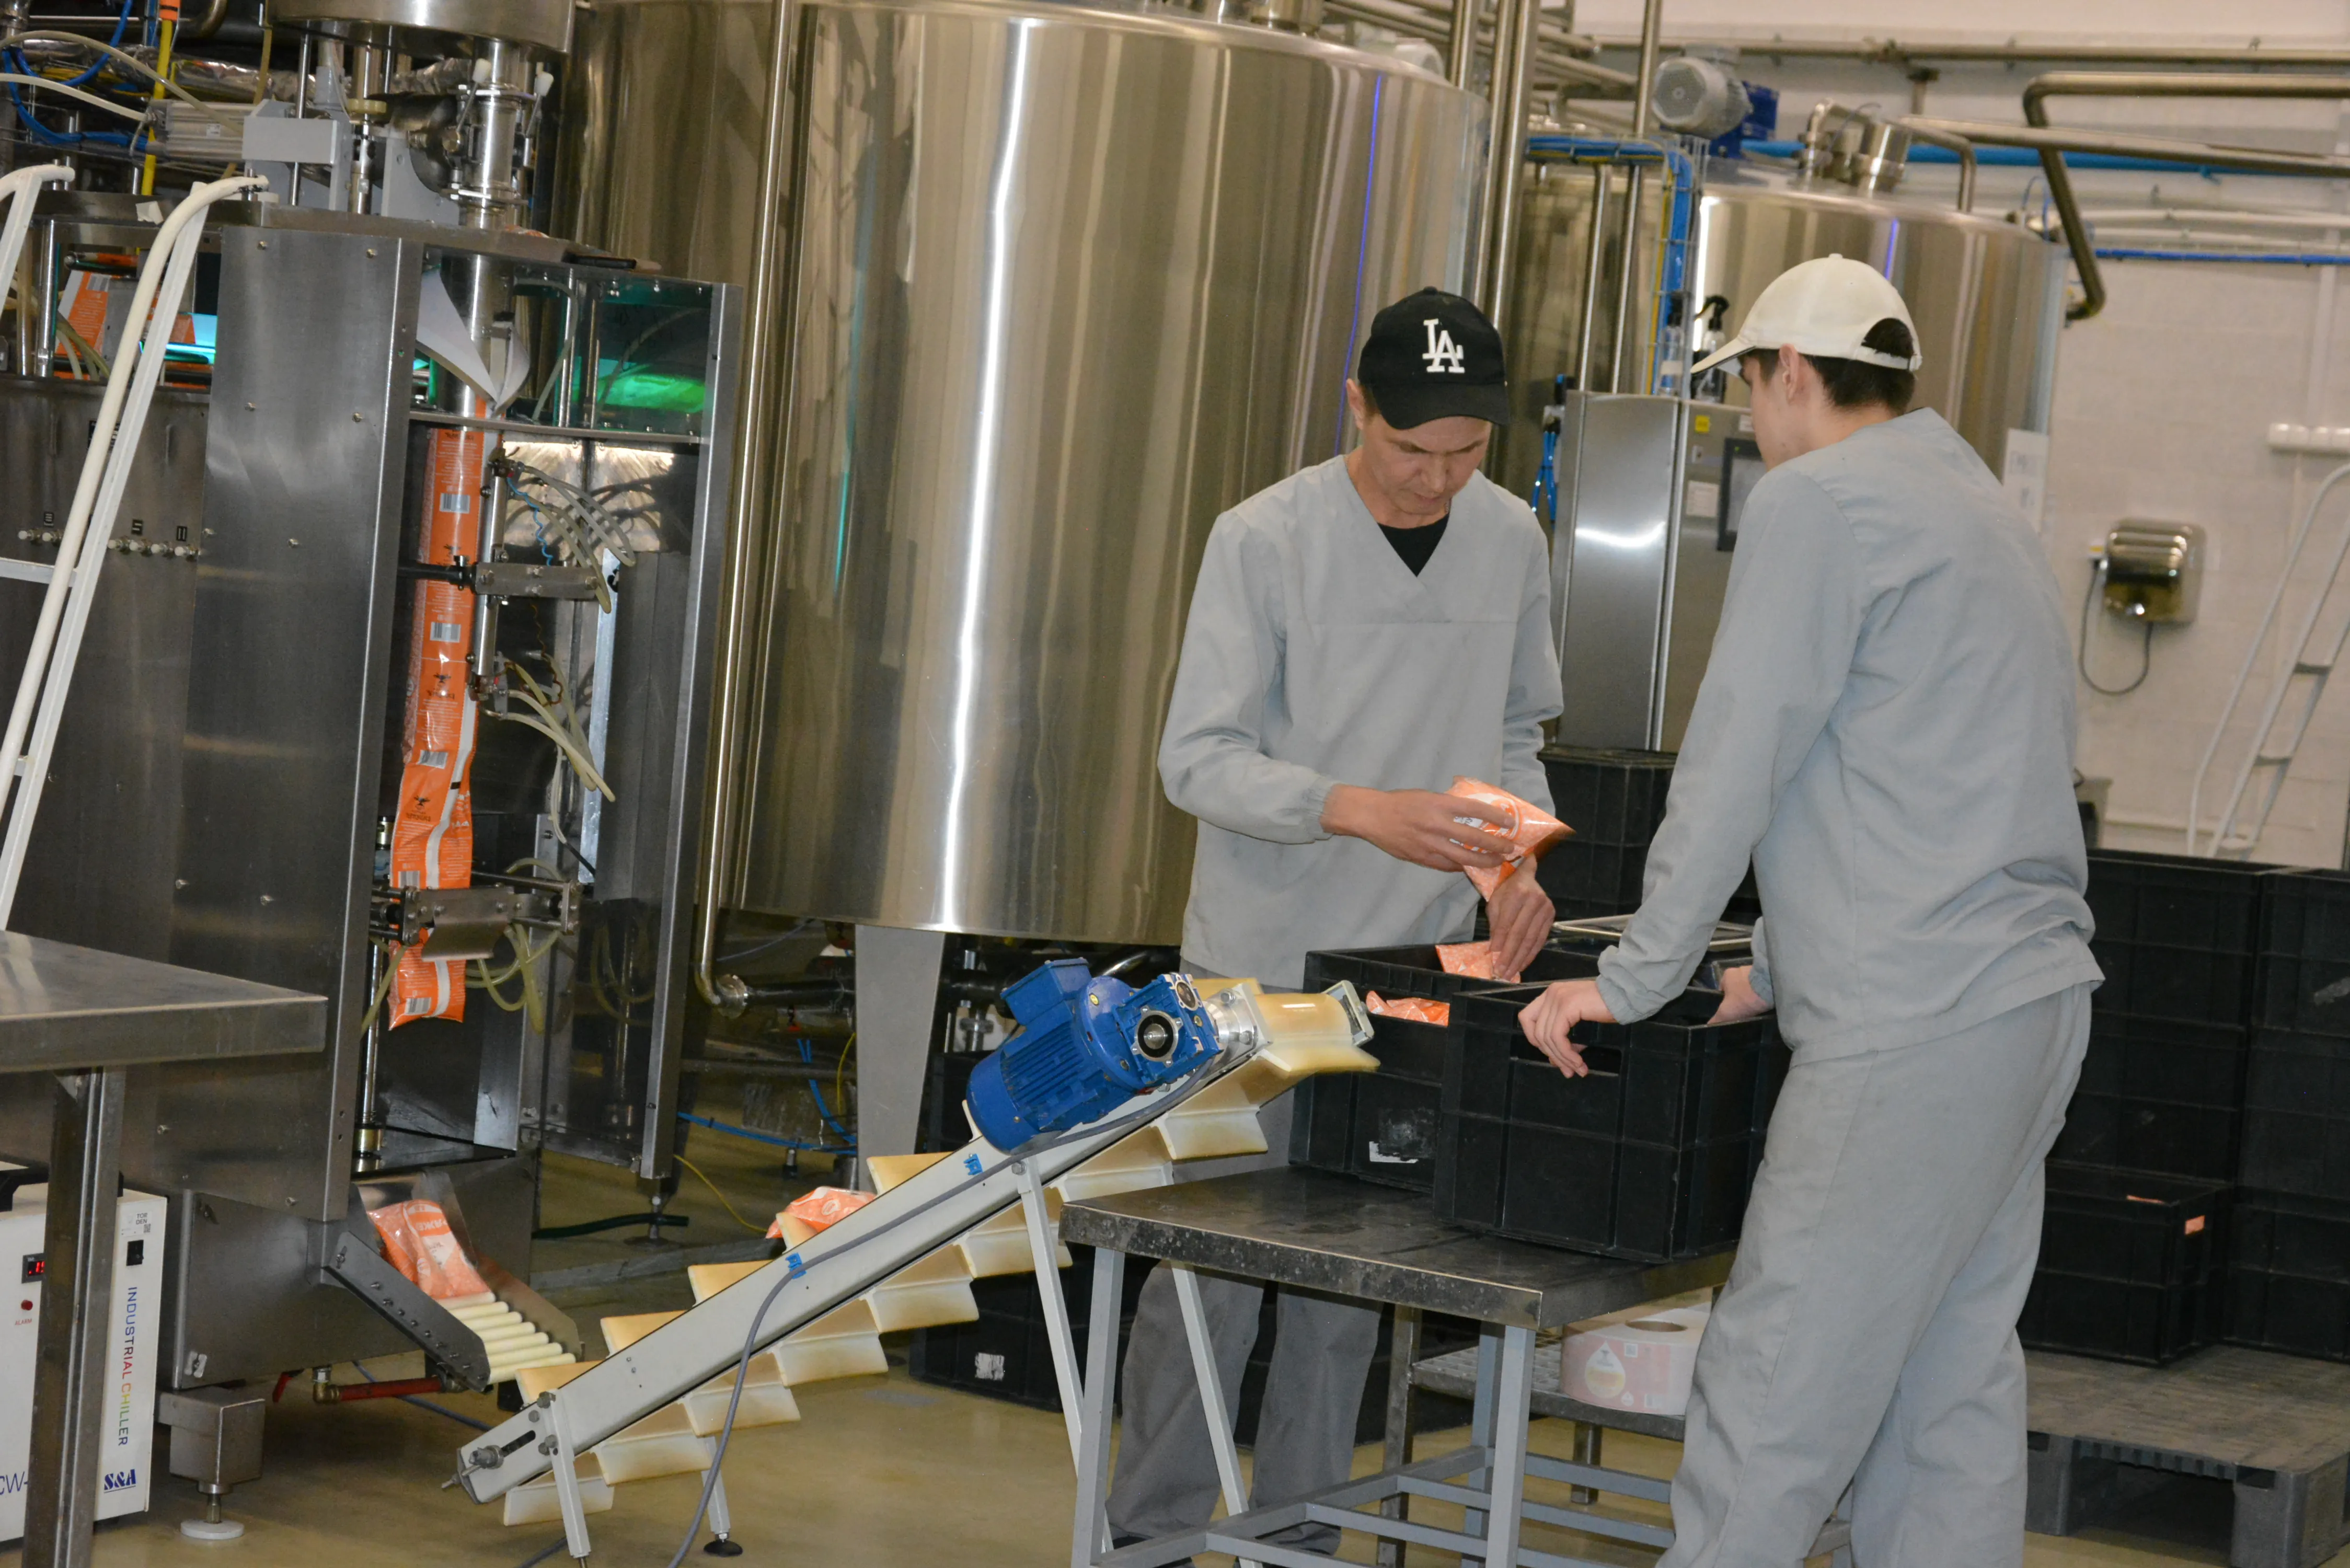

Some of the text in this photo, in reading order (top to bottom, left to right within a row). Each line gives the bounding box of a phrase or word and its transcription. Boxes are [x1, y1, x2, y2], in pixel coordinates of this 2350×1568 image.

[1422, 318, 1465, 373] LA
[118, 1286, 137, 1446] INDUSTRIAL CHILLER
[104, 1469, 136, 1491] S&A
